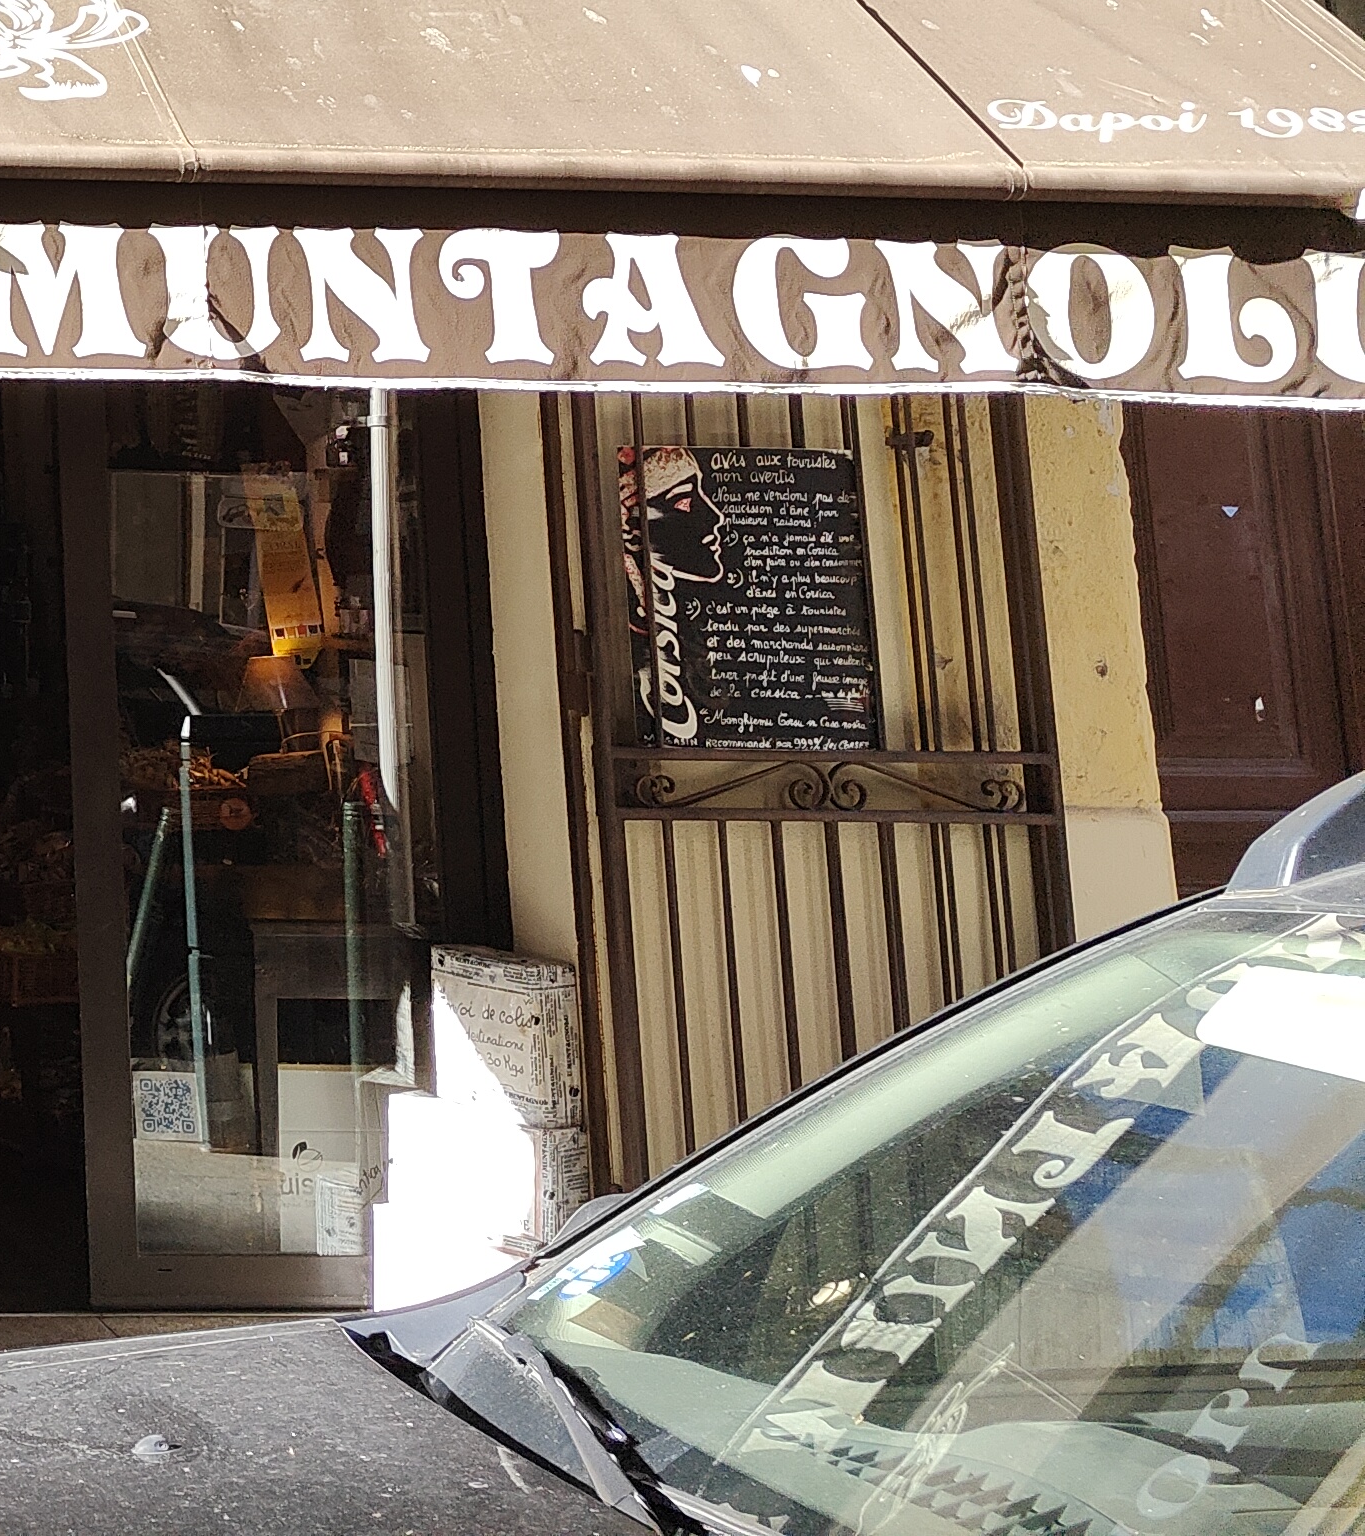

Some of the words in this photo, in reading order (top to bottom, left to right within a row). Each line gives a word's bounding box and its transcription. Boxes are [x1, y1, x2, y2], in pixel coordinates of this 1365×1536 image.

[986, 98, 1208, 143] Dapoi
[710, 450, 746, 470] avis
[756, 453, 782, 467] aux
[786, 452, 837, 469] touristes
[711, 471, 743, 483] non
[749, 469, 796, 484] avertis
[711, 486, 742, 502] Nous
[745, 490, 760, 502] ne
[763, 488, 808, 502] vendons
[812, 492, 834, 510] pas
[722, 504, 773, 514] saucisson
[815, 507, 839, 521] pour
[723, 515, 768, 531] plusieurs
[742, 533, 756, 546] ça
[760, 531, 779, 543] n'a
[783, 533, 817, 546] jamais
[744, 546, 794, 556] tradition
[796, 548, 807, 556] en
[807, 543, 840, 556] Corsica
[766, 558, 787, 571] faire
[790, 571, 811, 590] plus
[814, 573, 858, 587] beaucoup
[785, 590, 797, 598] en
[798, 585, 836, 599] Corsica
[705, 600, 734, 614] c'est
[735, 605, 749, 614] un
[800, 605, 847, 616] touristes
[700, 618, 740, 632] tendu
[744, 624, 769, 636] par
[773, 622, 791, 633] des
[706, 636, 721, 648] et
[726, 635, 746, 649] des
[750, 638, 814, 650] marchands
[706, 650, 732, 666] peu
[737, 650, 806, 670] scrupuleux
[813, 657, 831, 671] qui
[743, 670, 778, 687] profit
[780, 670, 806, 683] d'une
[751, 688, 802, 700] corsica
[482, 1004, 495, 1021] de
[486, 1052, 501, 1068] 30
